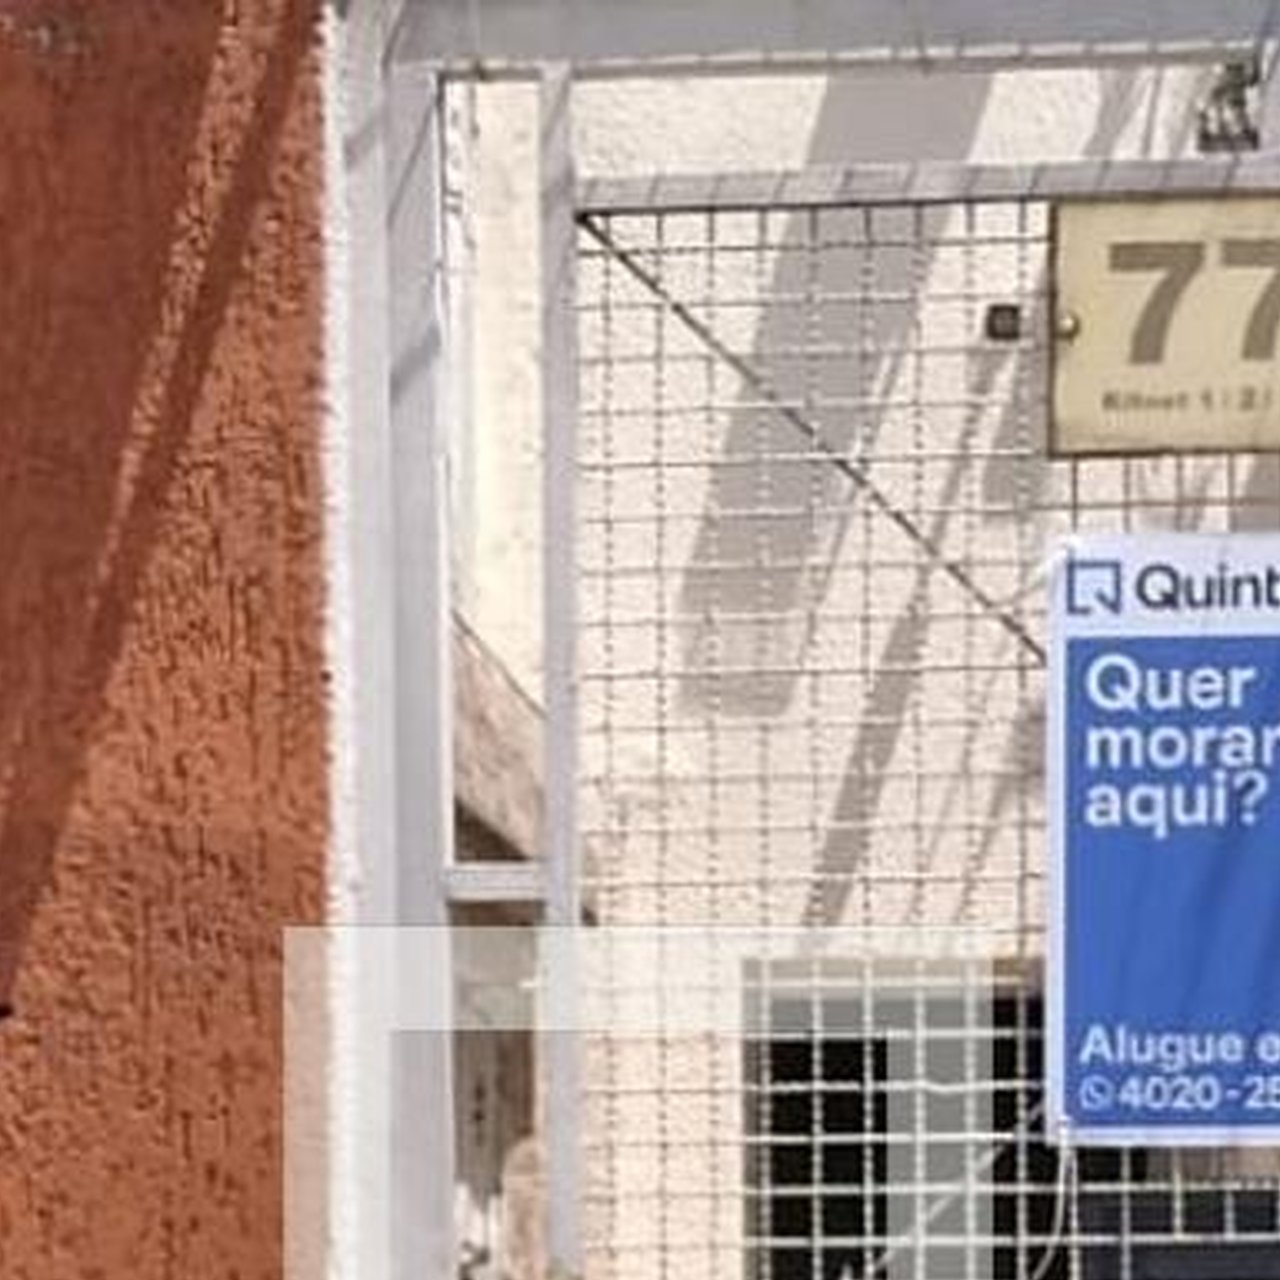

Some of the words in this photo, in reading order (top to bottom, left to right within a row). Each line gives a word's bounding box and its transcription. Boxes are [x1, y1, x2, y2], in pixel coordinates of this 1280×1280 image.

[1085, 653, 1257, 712] Quer
[1085, 770, 1269, 839] aqui?
[1079, 1023, 1245, 1074] Alugue
